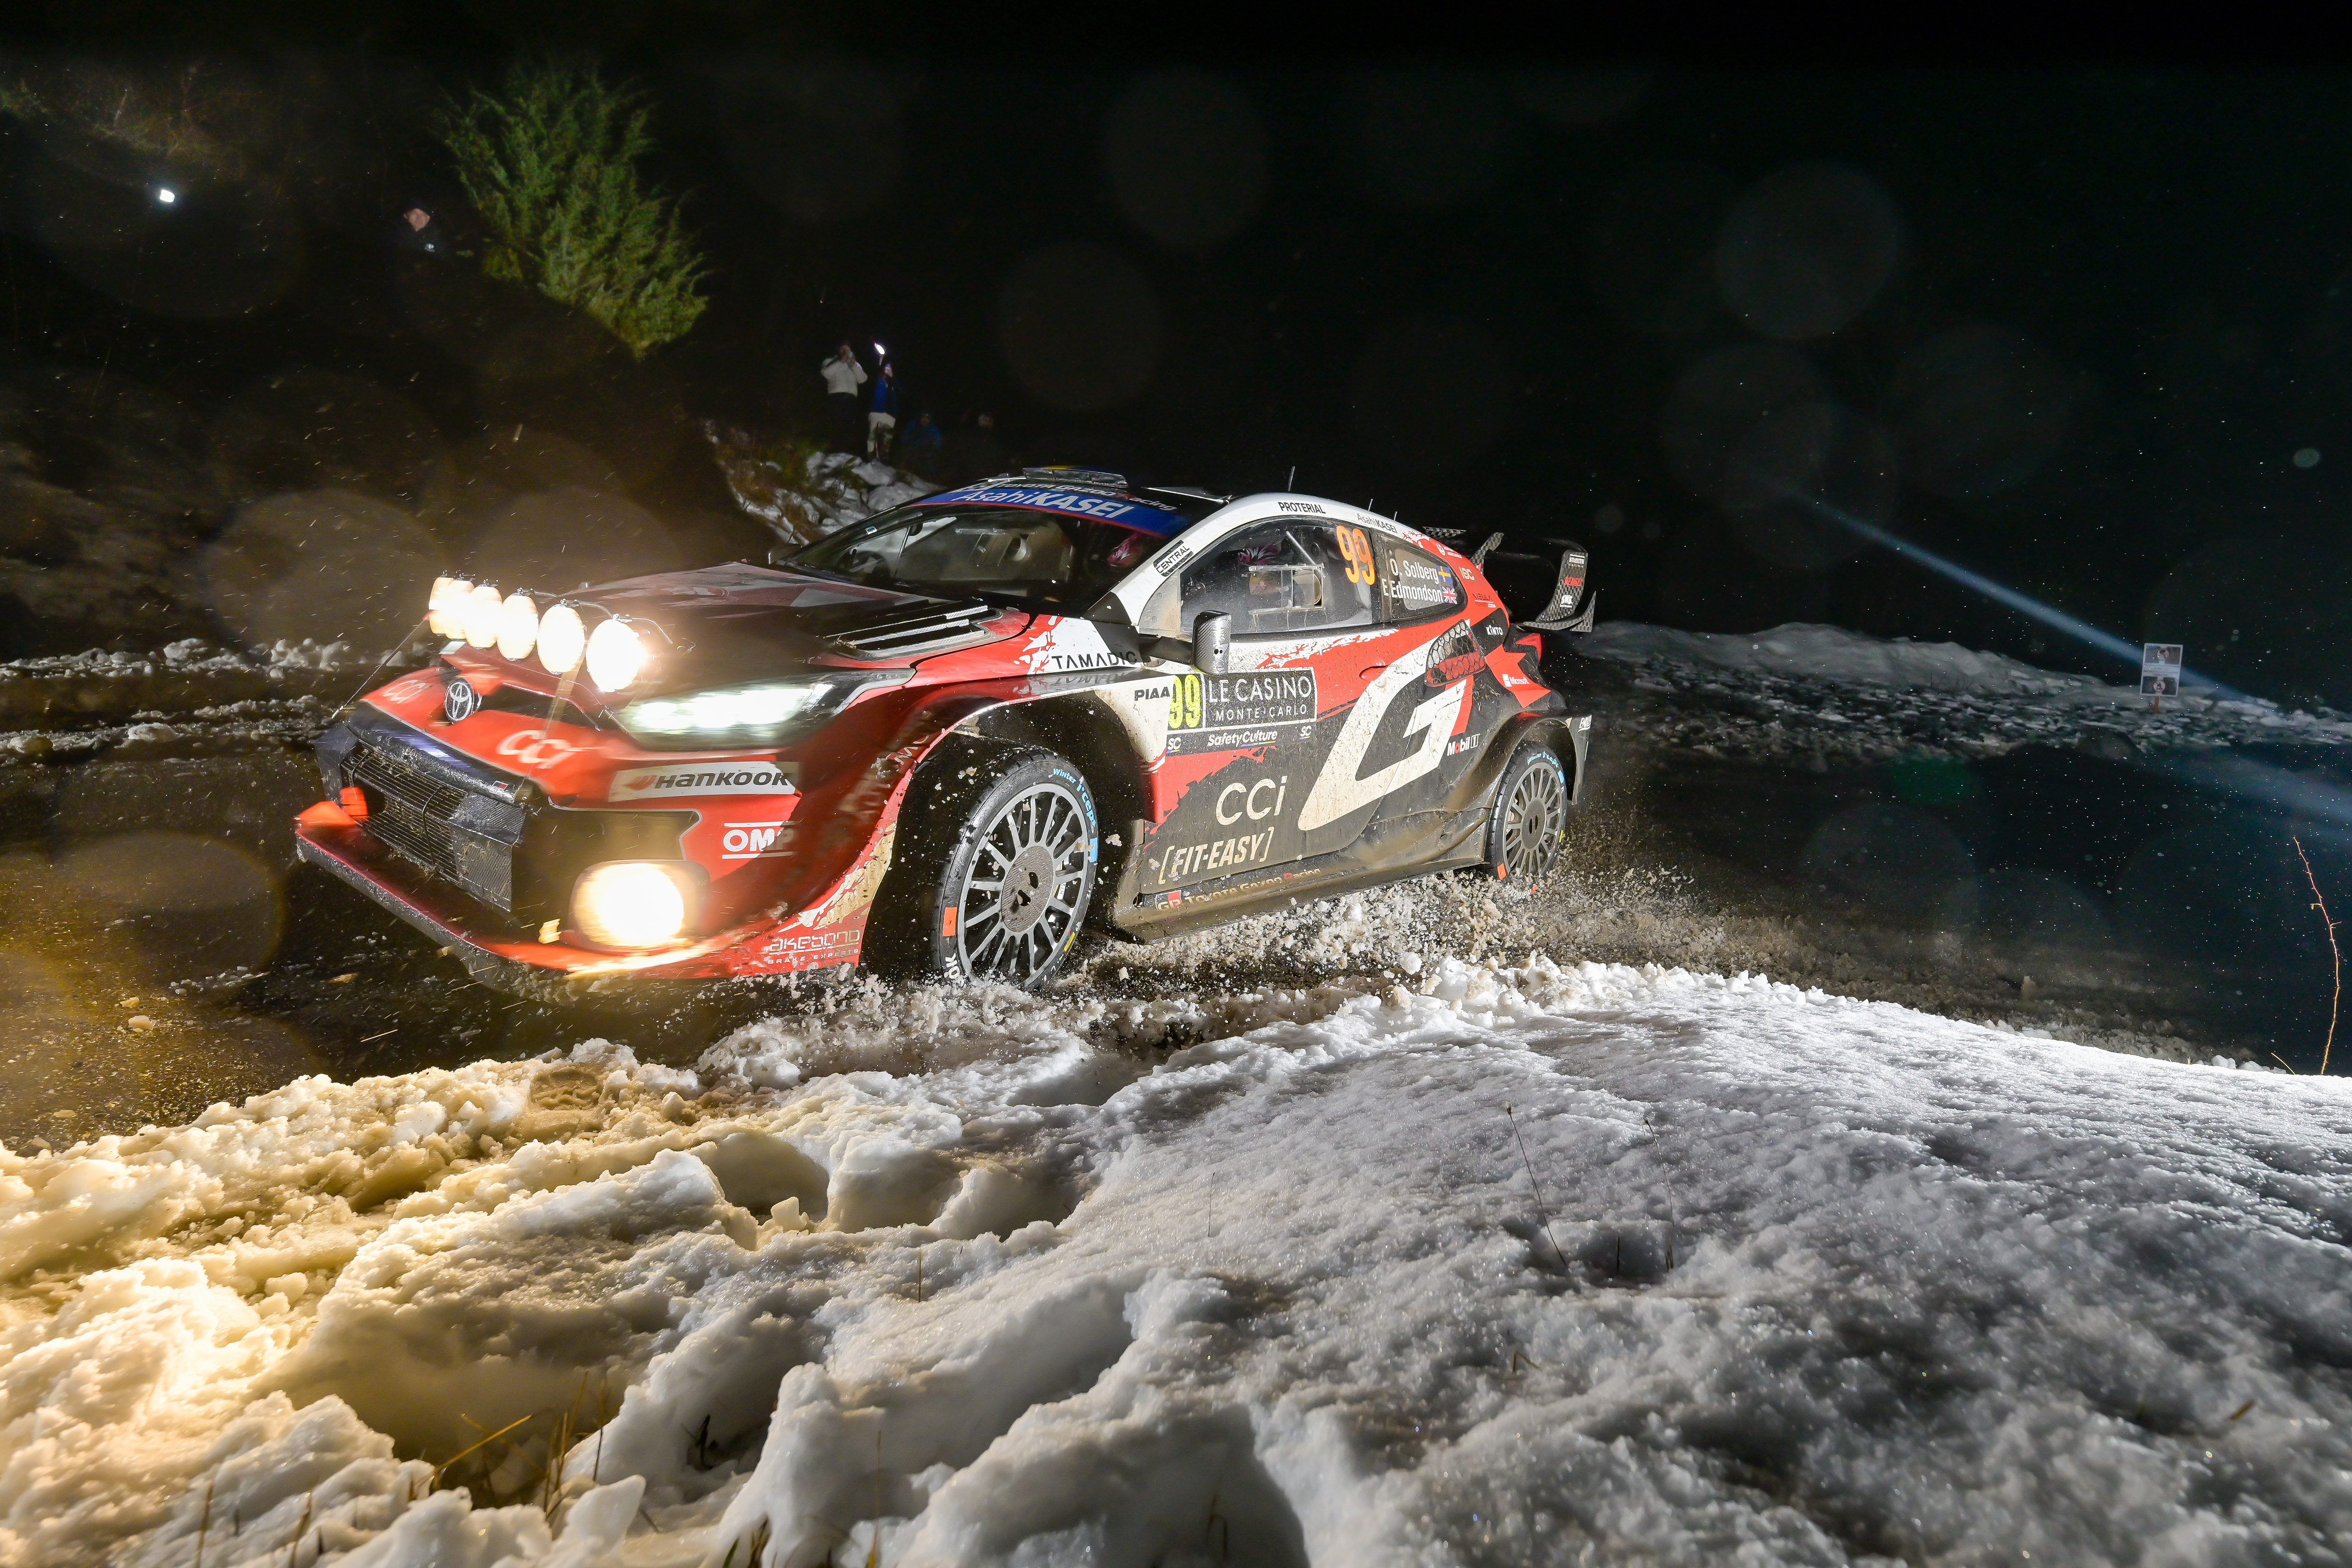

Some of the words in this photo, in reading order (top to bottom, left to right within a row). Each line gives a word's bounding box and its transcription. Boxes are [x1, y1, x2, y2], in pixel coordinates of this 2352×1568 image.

[1056, 485, 1116, 496] GAZOO
[952, 490, 1135, 519] AsahiKASEI
[1278, 501, 1326, 514] PROTERIAL
[1357, 513, 1398, 534] AsahiKASEI
[1156, 546, 1190, 574] CENTRAL
[1336, 525, 1375, 586] 99
[1390, 558, 1403, 576] O.
[1403, 560, 1439, 585] Solberg
[1564, 576, 1583, 586] DENSO
[1390, 580, 1444, 603] Edmondson
[1051, 651, 1137, 670] TAMADIC
[1208, 679, 1230, 703] LE
[1235, 675, 1312, 702] CASINO
[1510, 676, 1530, 685] Microsoft
[1134, 686, 1170, 702] PIAA
[1168, 674, 1201, 729] 99
[1207, 730, 1278, 748] SafetyCulture
[1300, 725, 1312, 737] SC
[1168, 737, 1182, 751] SC
[1447, 736, 1470, 757] Mobil
[1053, 768, 1077, 784] Winter
[1216, 776, 1288, 826] CCi
[723, 828, 795, 852] OMP
[769, 929, 860, 951] akebono
[767, 956, 806, 965] BRAKE
[813, 949, 859, 960] EXPERTS
